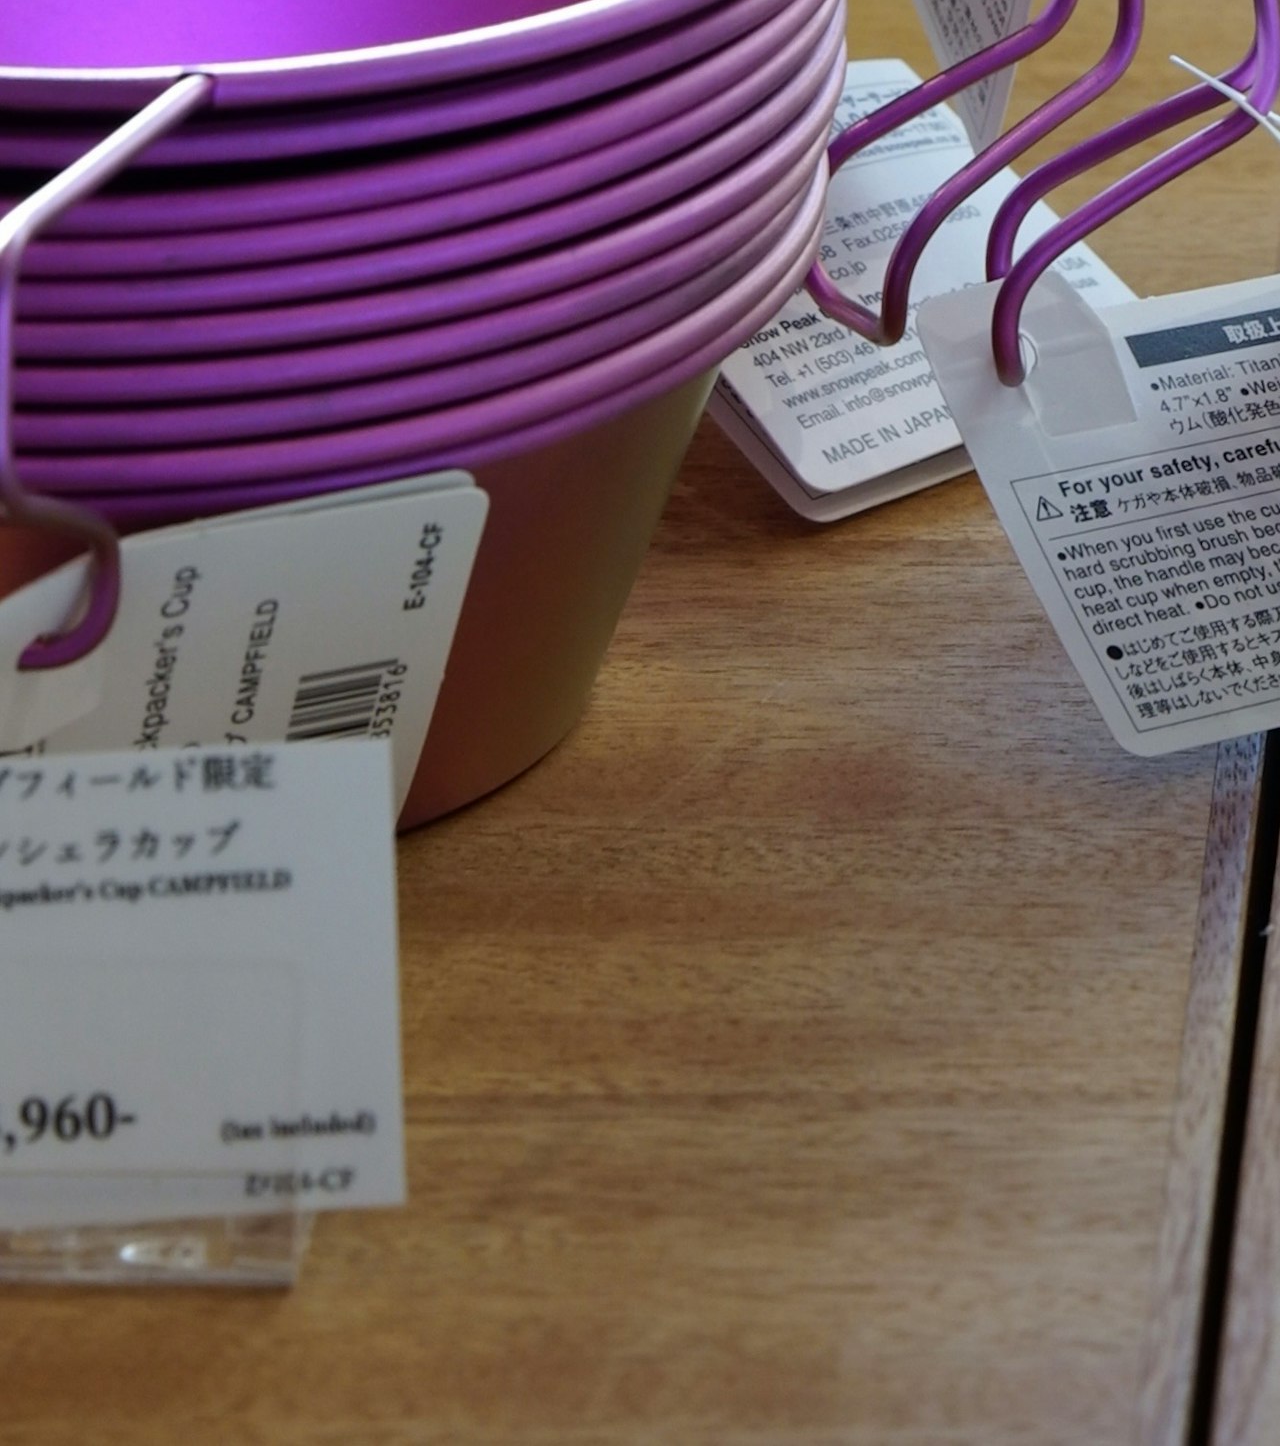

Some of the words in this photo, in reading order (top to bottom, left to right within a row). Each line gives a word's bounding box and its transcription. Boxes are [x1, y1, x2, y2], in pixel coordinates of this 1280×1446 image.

[779, 312, 822, 334] Peak
[753, 349, 782, 369] 404
[781, 336, 808, 355] NW
[809, 326, 846, 349] 23rd
[765, 372, 796, 389] Tel.
[816, 348, 855, 375] (503)
[1159, 366, 1235, 392] Material:
[796, 405, 844, 430] Email.
[821, 433, 879, 465] MADE
[880, 424, 902, 443] IN
[1058, 479, 1094, 498] For
[1099, 470, 1144, 494] your
[1149, 453, 1220, 480] safety,
[1069, 499, 1113, 524] 注意
[1064, 561, 1106, 582] hard
[1108, 540, 1197, 572] scrubbing
[1199, 528, 1250, 551] brush
[1065, 541, 1118, 561] When
[1122, 532, 1154, 551] you
[1156, 522, 1192, 542] first
[1195, 516, 1226, 533] use
[1228, 508, 1257, 526] the
[403, 522, 443, 612] E-104-CF
[1074, 580, 1114, 601] cup,
[1114, 573, 1144, 591] the
[1146, 559, 1206, 584] handle
[1209, 551, 1247, 571] may
[1082, 598, 1122, 618] heat
[1124, 589, 1159, 609] cup
[1162, 579, 1211, 600] when
[1212, 564, 1272, 589] empty,
[1092, 614, 1143, 637] direct
[1146, 601, 1191, 624] heat.
[1203, 593, 1231, 611] Do
[1233, 585, 1264, 603] not
[134, 623, 184, 751] kpacker's
[161, 565, 203, 621] Cup
[230, 598, 279, 725] CAMPFIELD
[101, 878, 142, 904] Cup
[148, 867, 292, 896] CAMPFIELD
